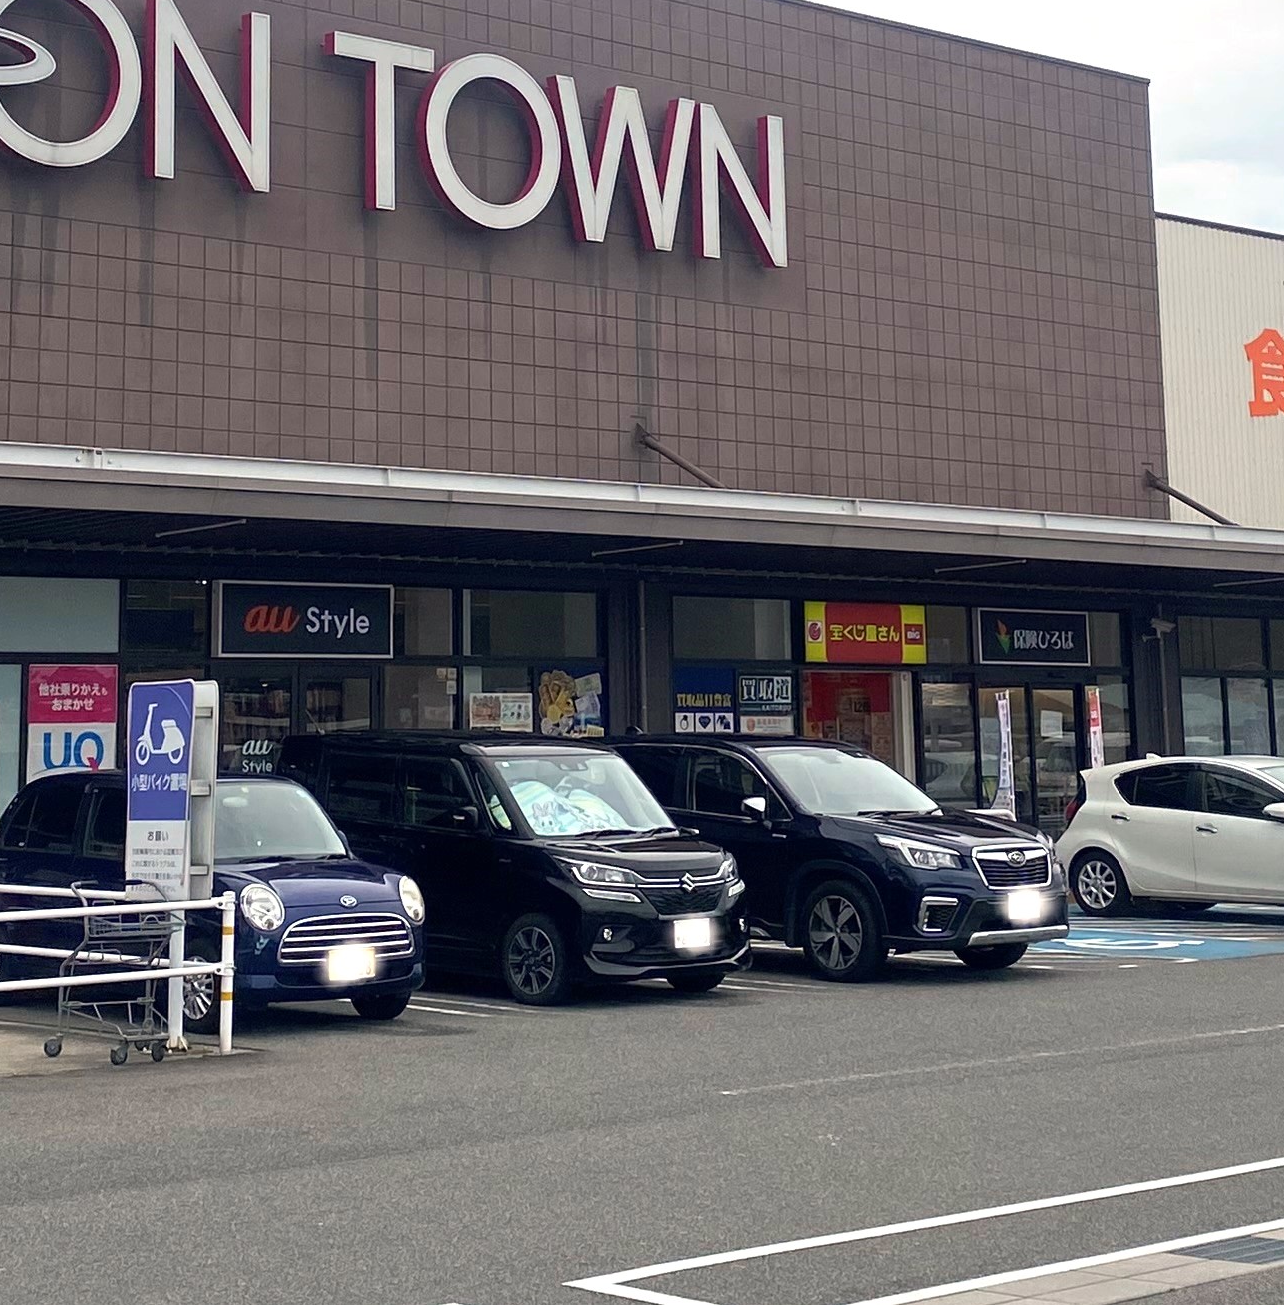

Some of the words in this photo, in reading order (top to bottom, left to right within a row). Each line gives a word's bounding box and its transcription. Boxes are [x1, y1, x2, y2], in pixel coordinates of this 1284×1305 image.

[325, 30, 787, 269] TOWN
[243, 605, 301, 633] au
[305, 606, 371, 639] Style
[1013, 629, 1075, 650] 保険ひろば
[51, 698, 95, 712] おまかせ
[43, 731, 105, 774] UQ
[242, 739, 274, 755] au
[242, 759, 274, 774] Style
